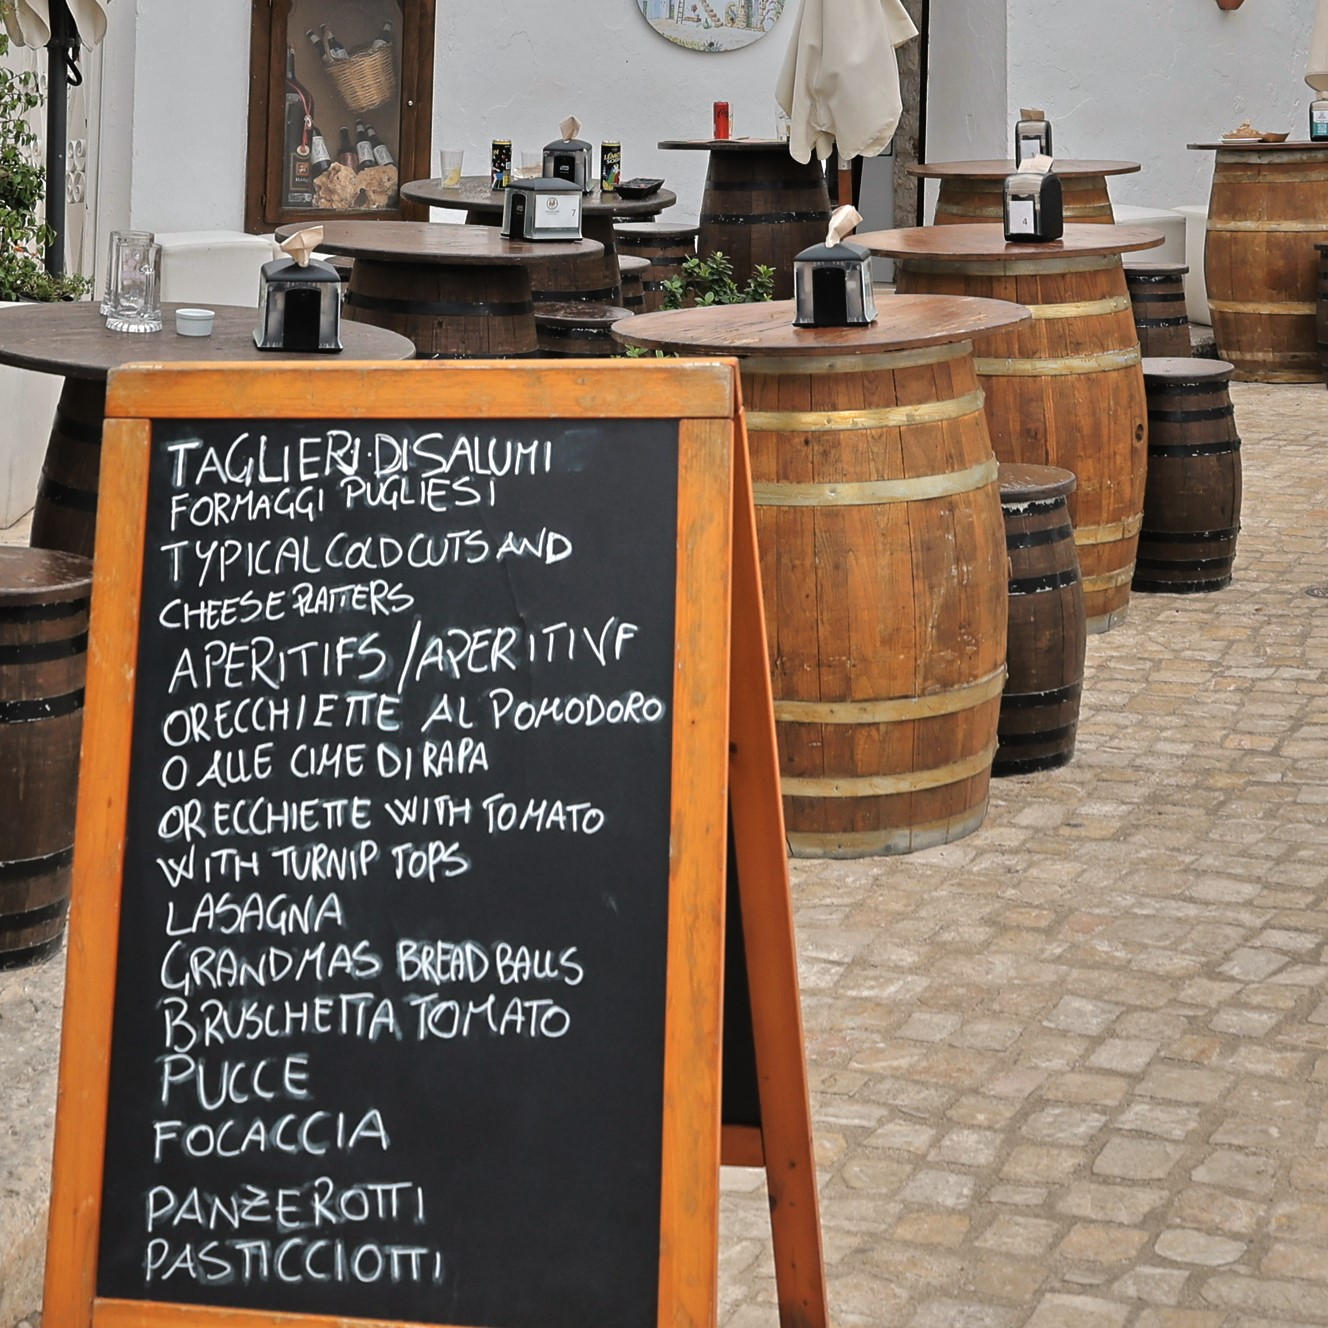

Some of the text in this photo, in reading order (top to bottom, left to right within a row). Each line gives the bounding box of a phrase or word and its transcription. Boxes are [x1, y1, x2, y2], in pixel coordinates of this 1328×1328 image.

[168, 429, 360, 488] TAGLIERI
[413, 433, 552, 476] SALUMI
[170, 475, 496, 532] FORMAGGI PUGLIESI
[161, 536, 320, 587] TYPICAL
[407, 528, 489, 568] CUTS
[497, 528, 572, 564] AND
[160, 580, 415, 630] CHEESE PLATTERS
[169, 636, 388, 694] APERITIFS
[163, 688, 665, 748] ORECCHIETTE AL POMODORO
[162, 738, 489, 791] O ALLE CIME DI RAPA
[158, 792, 604, 841] ORECCHIETTE WITH TOMATO
[157, 841, 470, 887] WITH TURNIP TOPS
[166, 892, 343, 937] LASAGNA
[161, 940, 583, 993] GRANDMAS BREAD BALLS
[161, 993, 570, 1051] BRUSCHETTA TOMATO
[160, 1053, 310, 1110] PUCCE
[154, 1110, 389, 1162] FOCACCIA
[146, 1177, 424, 1232] PANZEROTTI
[145, 1238, 443, 1281] PASTICCIOTTI
